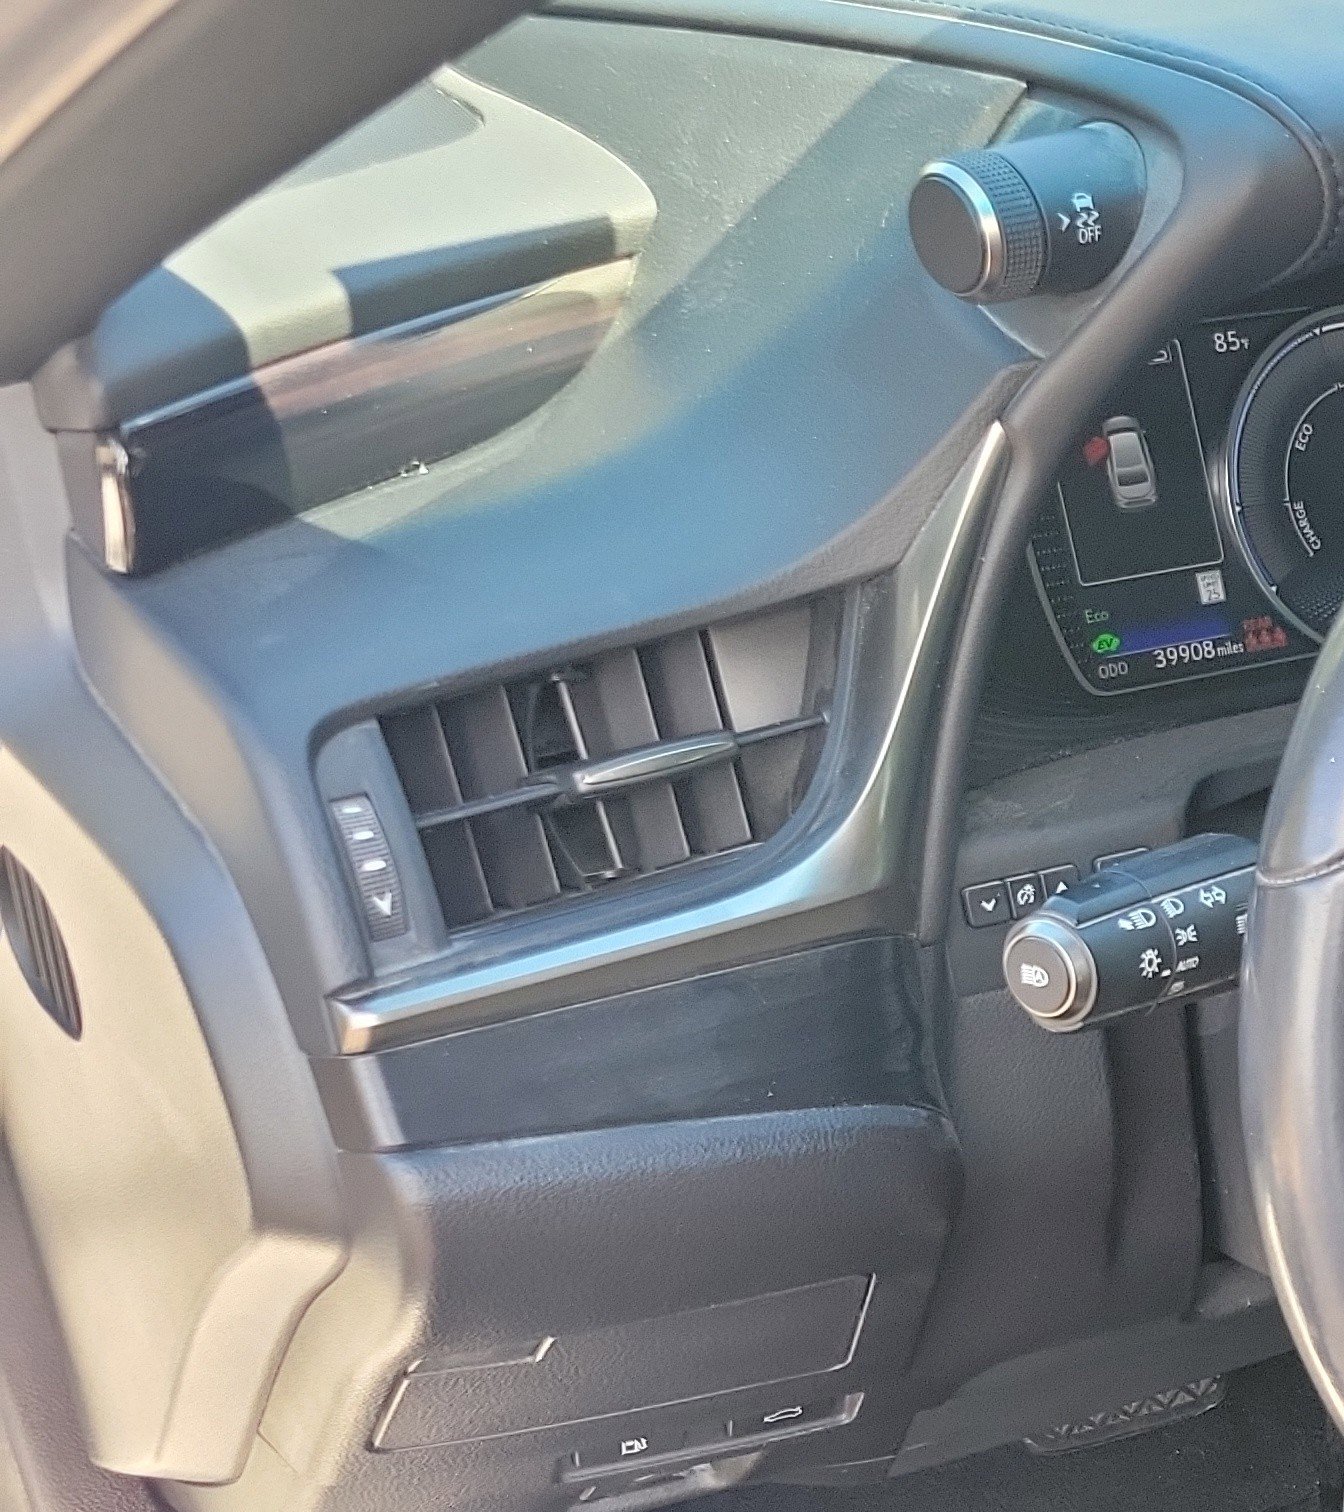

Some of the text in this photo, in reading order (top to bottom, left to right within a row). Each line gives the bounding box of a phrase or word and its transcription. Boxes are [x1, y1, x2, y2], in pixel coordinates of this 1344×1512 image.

[1078, 225, 1102, 245] OFF
[1295, 423, 1314, 451] ECO
[1292, 501, 1322, 551] CHARGE
[1084, 609, 1109, 624] Eco
[1152, 640, 1244, 669] 39908 miles
[1098, 661, 1129, 679] ODO
